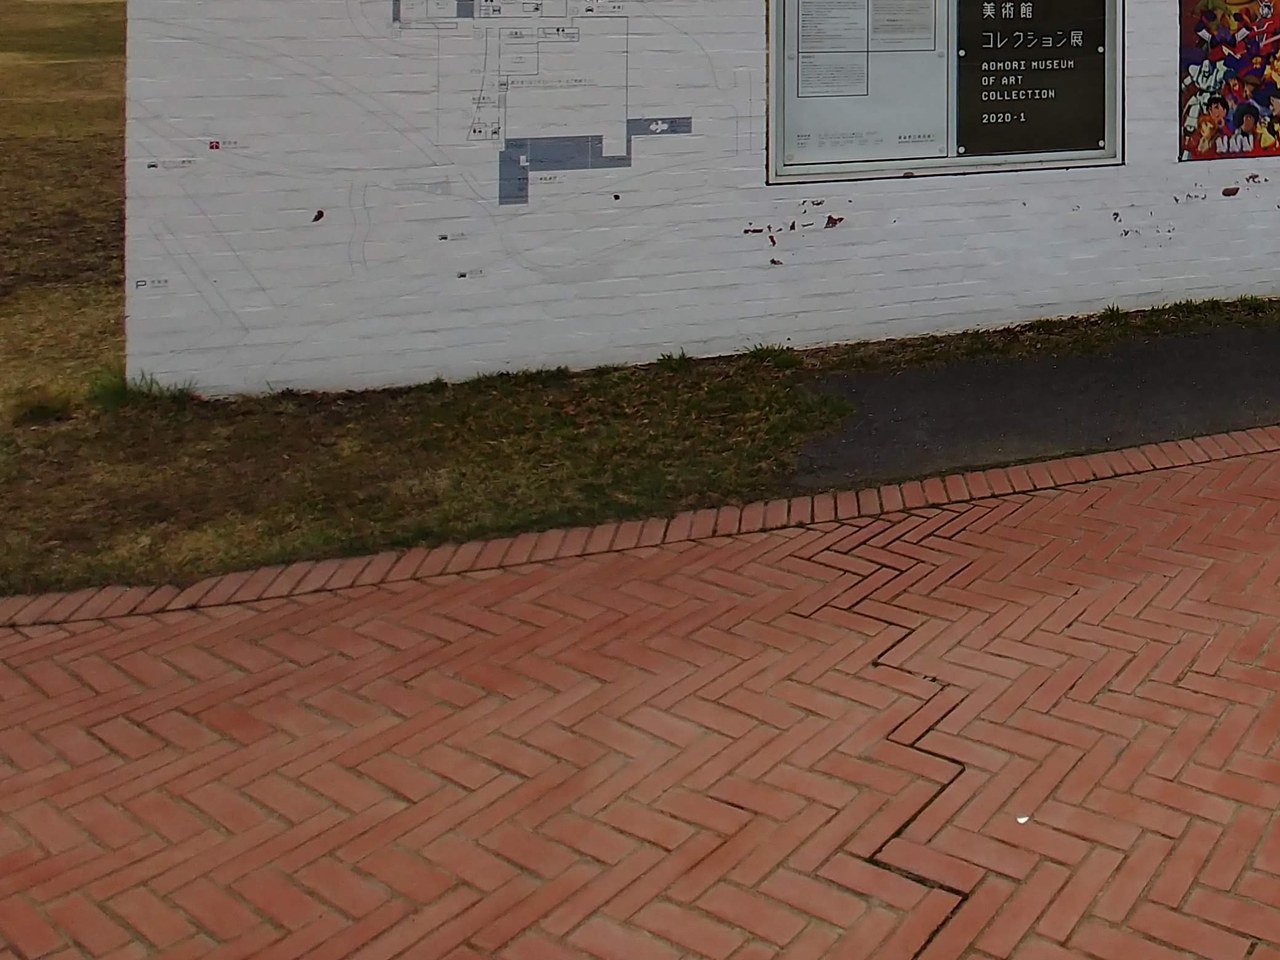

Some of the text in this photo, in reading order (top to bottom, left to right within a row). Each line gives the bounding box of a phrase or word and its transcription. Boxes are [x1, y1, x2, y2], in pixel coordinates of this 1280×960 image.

[981, 1, 1034, 19] 美術館
[981, 30, 1084, 49] コレクション展
[981, 59, 1075, 71] AOMORI MUSEUM
[981, 75, 1024, 86] OF ART
[981, 89, 1056, 101] COLLECTION
